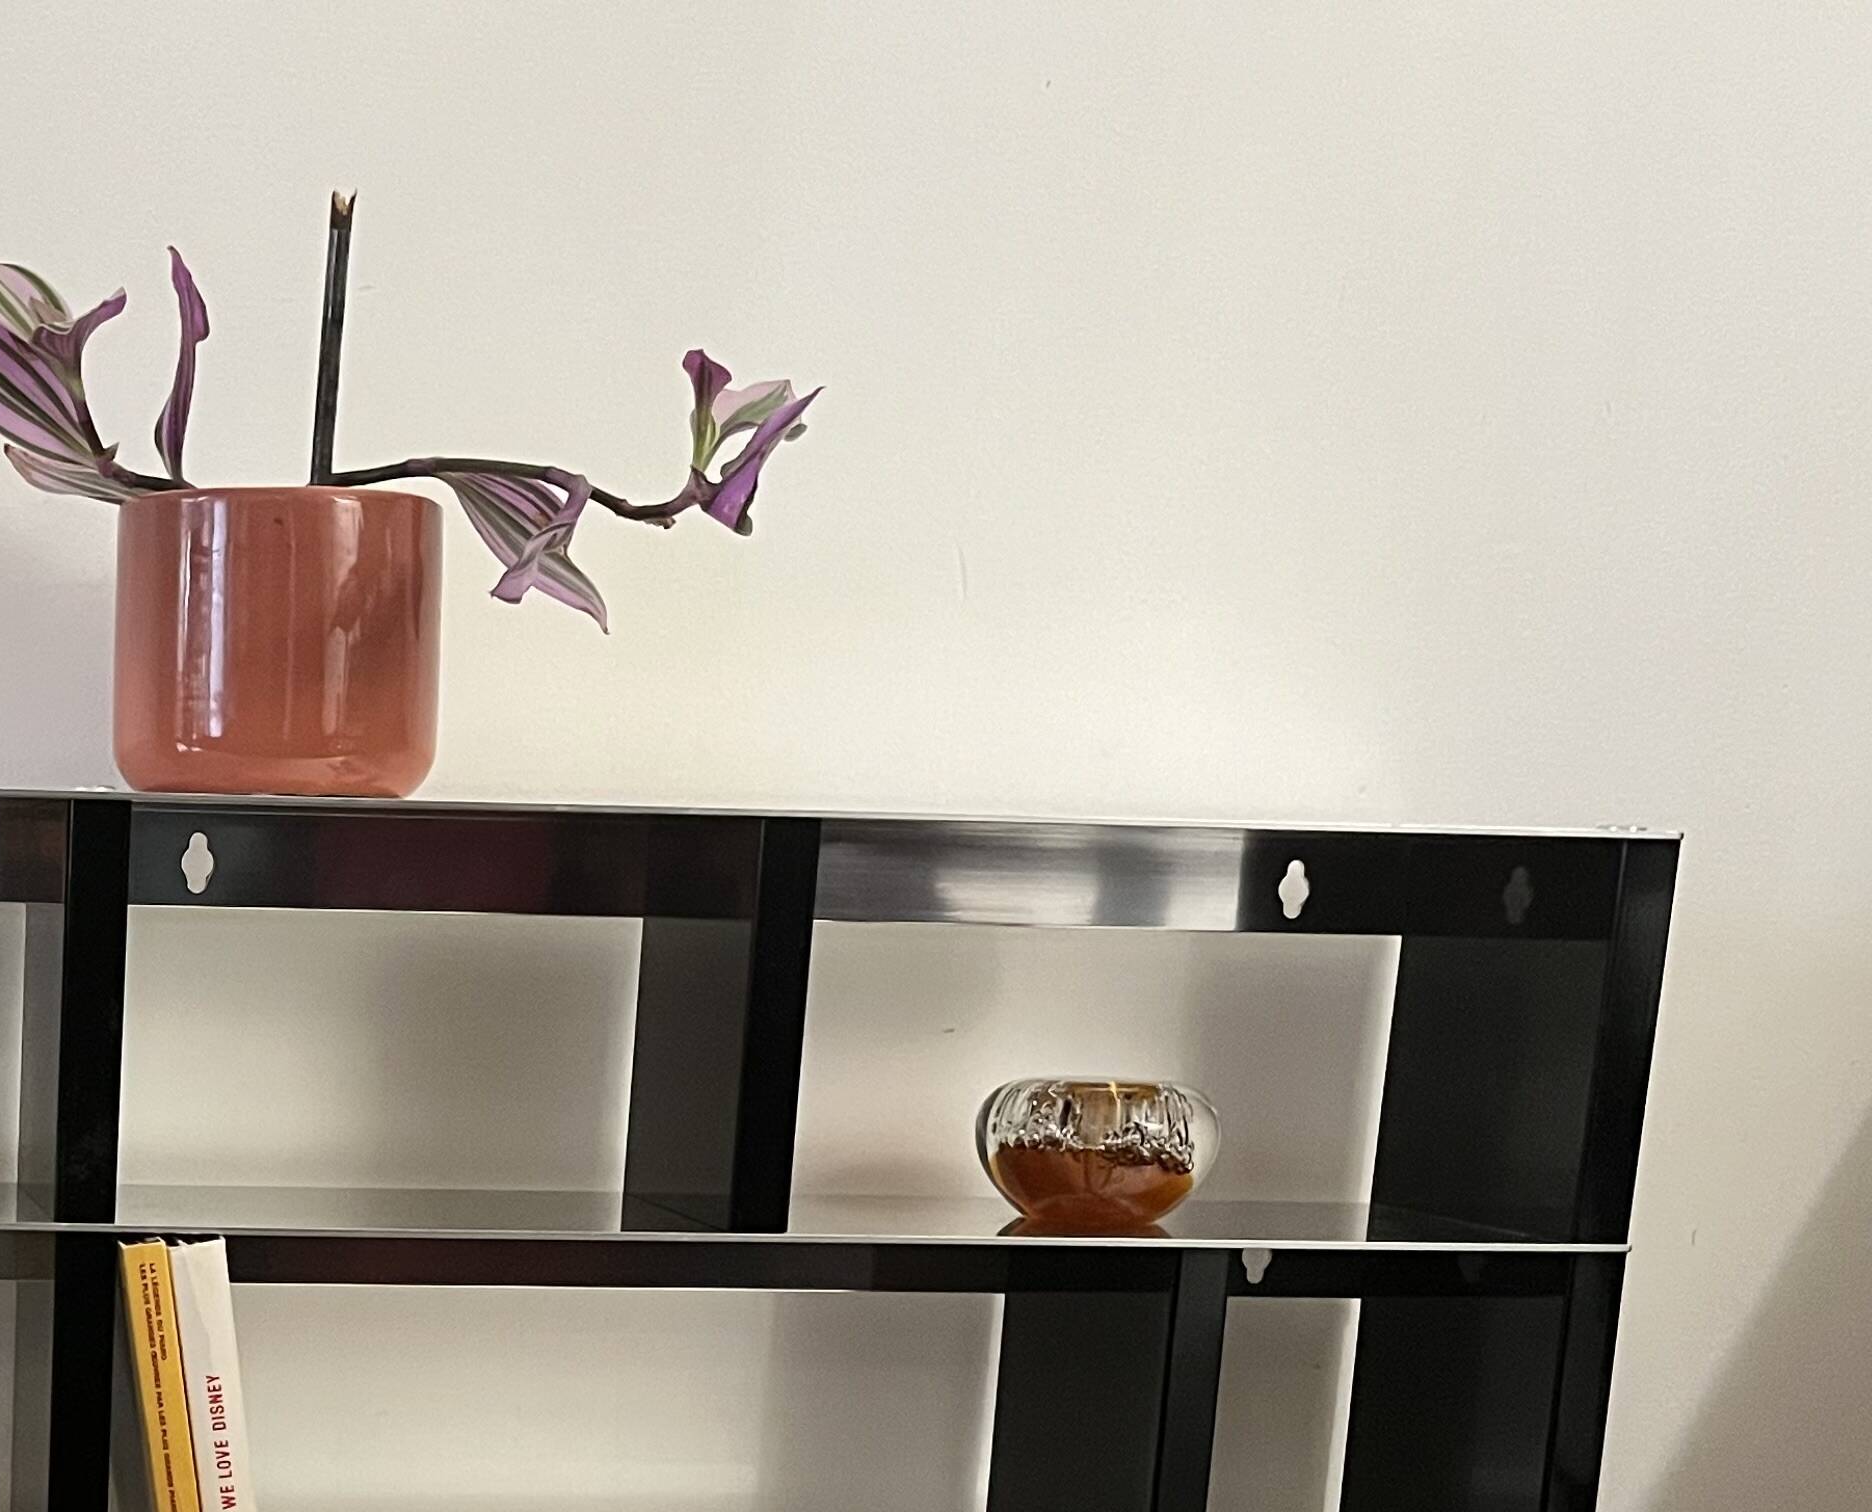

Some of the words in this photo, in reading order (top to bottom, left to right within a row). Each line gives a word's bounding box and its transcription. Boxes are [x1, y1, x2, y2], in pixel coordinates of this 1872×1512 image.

[149, 1263, 156, 1273] LA
[157, 1320, 164, 1332] DU
[206, 1375, 226, 1431] DISNEY
[214, 1440, 232, 1478] LOVE
[220, 1485, 236, 1509] WE
